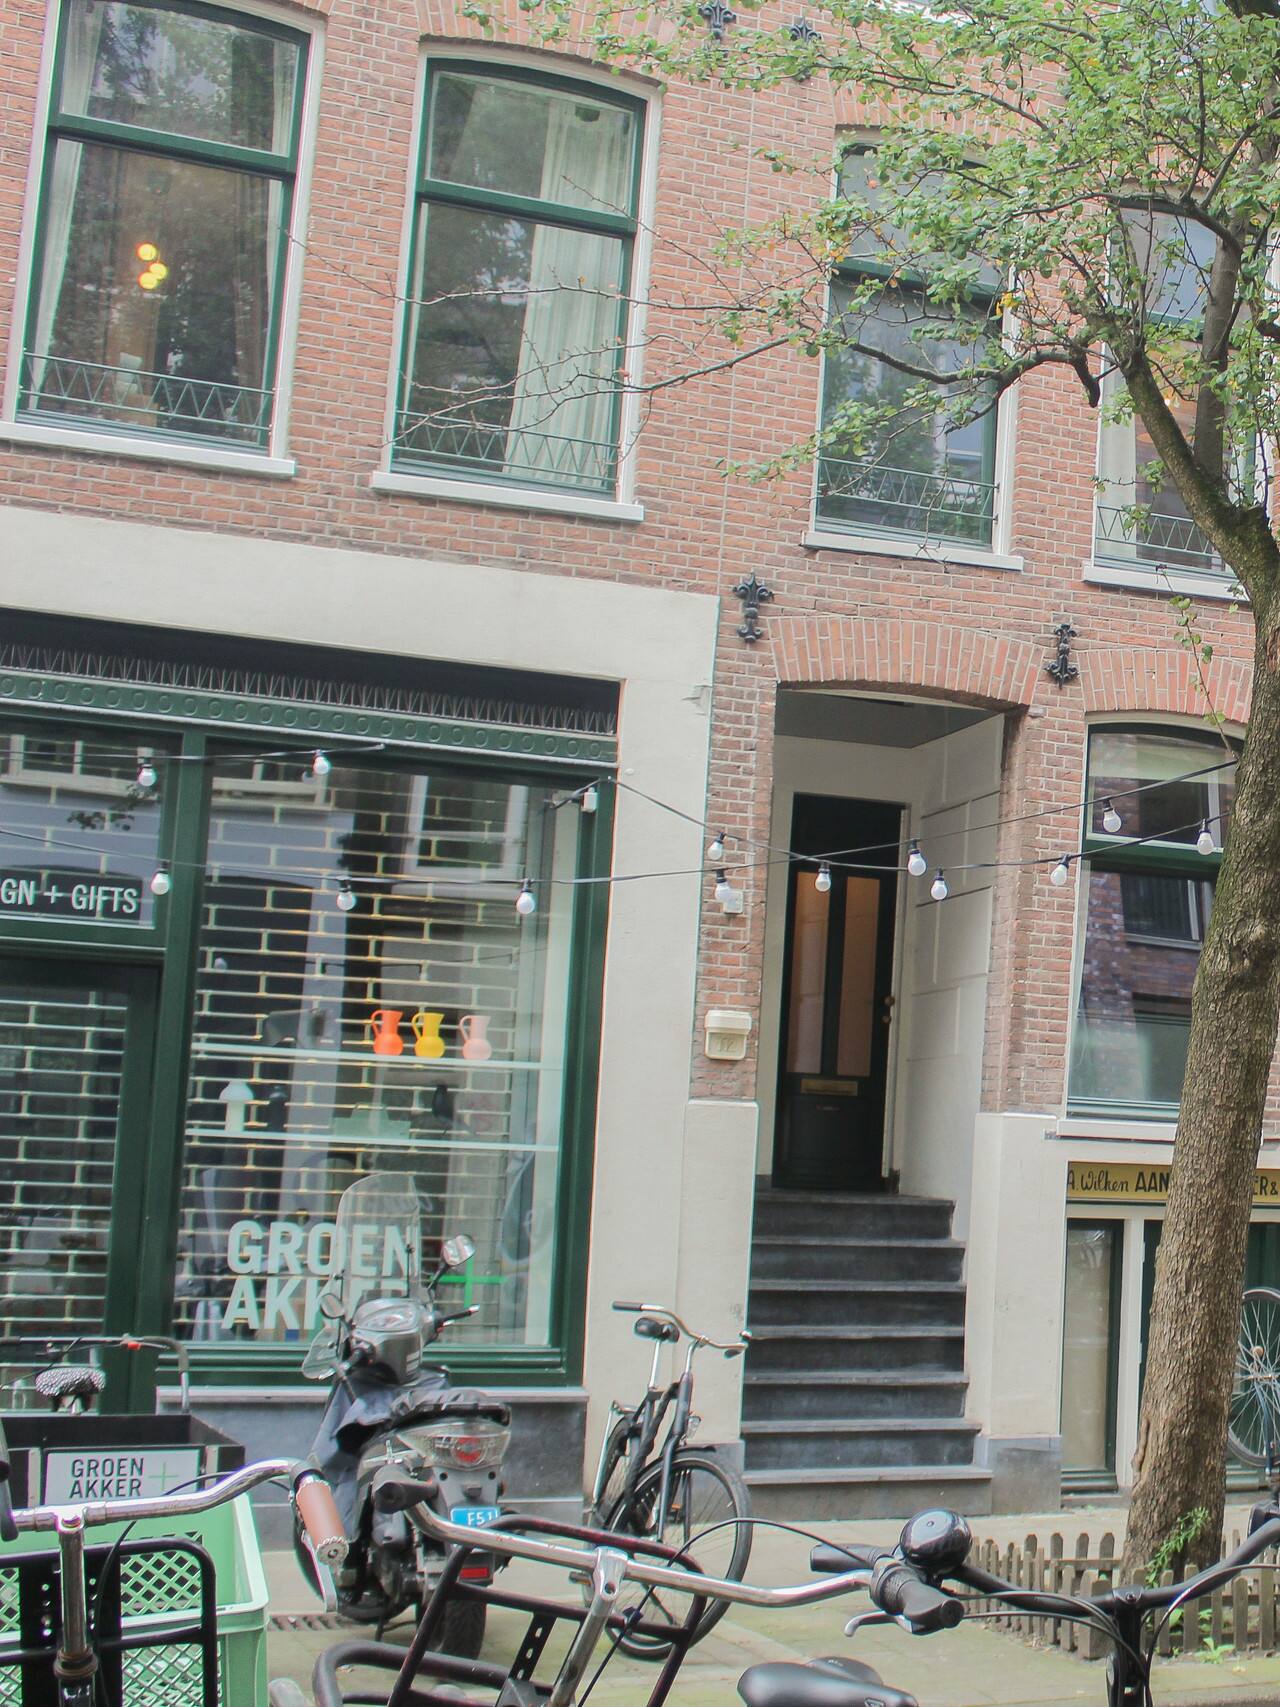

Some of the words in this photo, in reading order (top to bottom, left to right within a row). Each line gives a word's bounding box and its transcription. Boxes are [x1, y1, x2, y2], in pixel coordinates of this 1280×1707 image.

[71, 884, 138, 914] GIFTS
[1080, 1168, 1129, 1193] Wilken
[227, 1219, 420, 1277] GROEN
[70, 1457, 144, 1478] GROEN
[69, 1478, 142, 1499] AKKER
